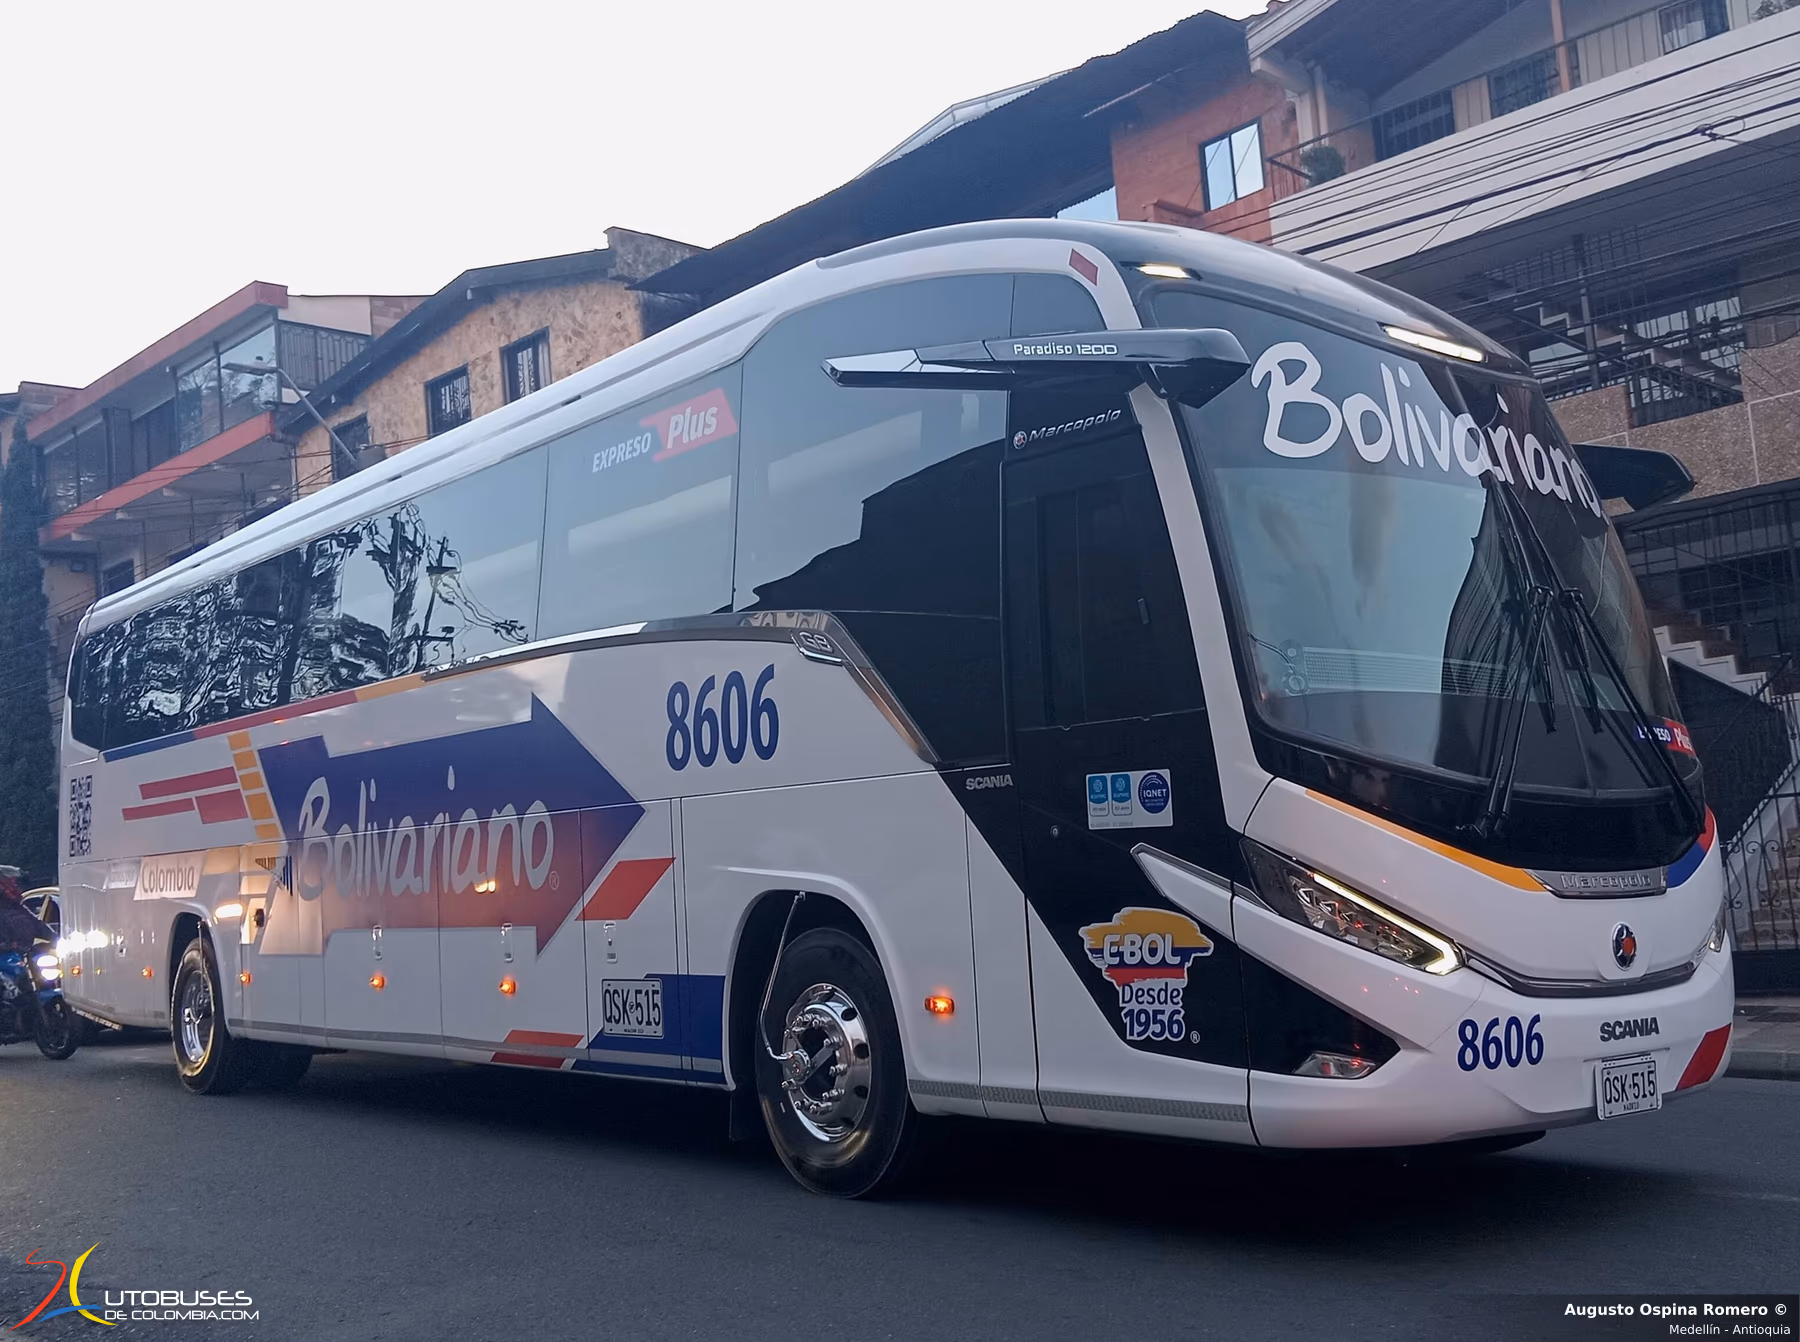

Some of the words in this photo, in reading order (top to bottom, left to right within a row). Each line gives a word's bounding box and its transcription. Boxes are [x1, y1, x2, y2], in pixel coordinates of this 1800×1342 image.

[1013, 342, 1073, 355] Paradiso
[1076, 344, 1118, 355] 1200
[592, 432, 652, 473] EXPRESO
[667, 406, 718, 449] Plus
[1029, 409, 1121, 441] Marcopolo
[1251, 341, 1601, 517] Bolivariano
[666, 663, 779, 771] 8606
[965, 774, 1014, 790] SCANIA
[1143, 788, 1167, 798] IQNET
[299, 765, 554, 901] Bolivariano
[142, 865, 195, 893] Colombia
[1560, 872, 1653, 890] Marcopolo
[1120, 982, 1181, 1005] Desde
[1123, 1008, 1184, 1039] 1956
[1600, 1017, 1660, 1042] SCANIA
[1457, 1013, 1544, 1072] 8606
